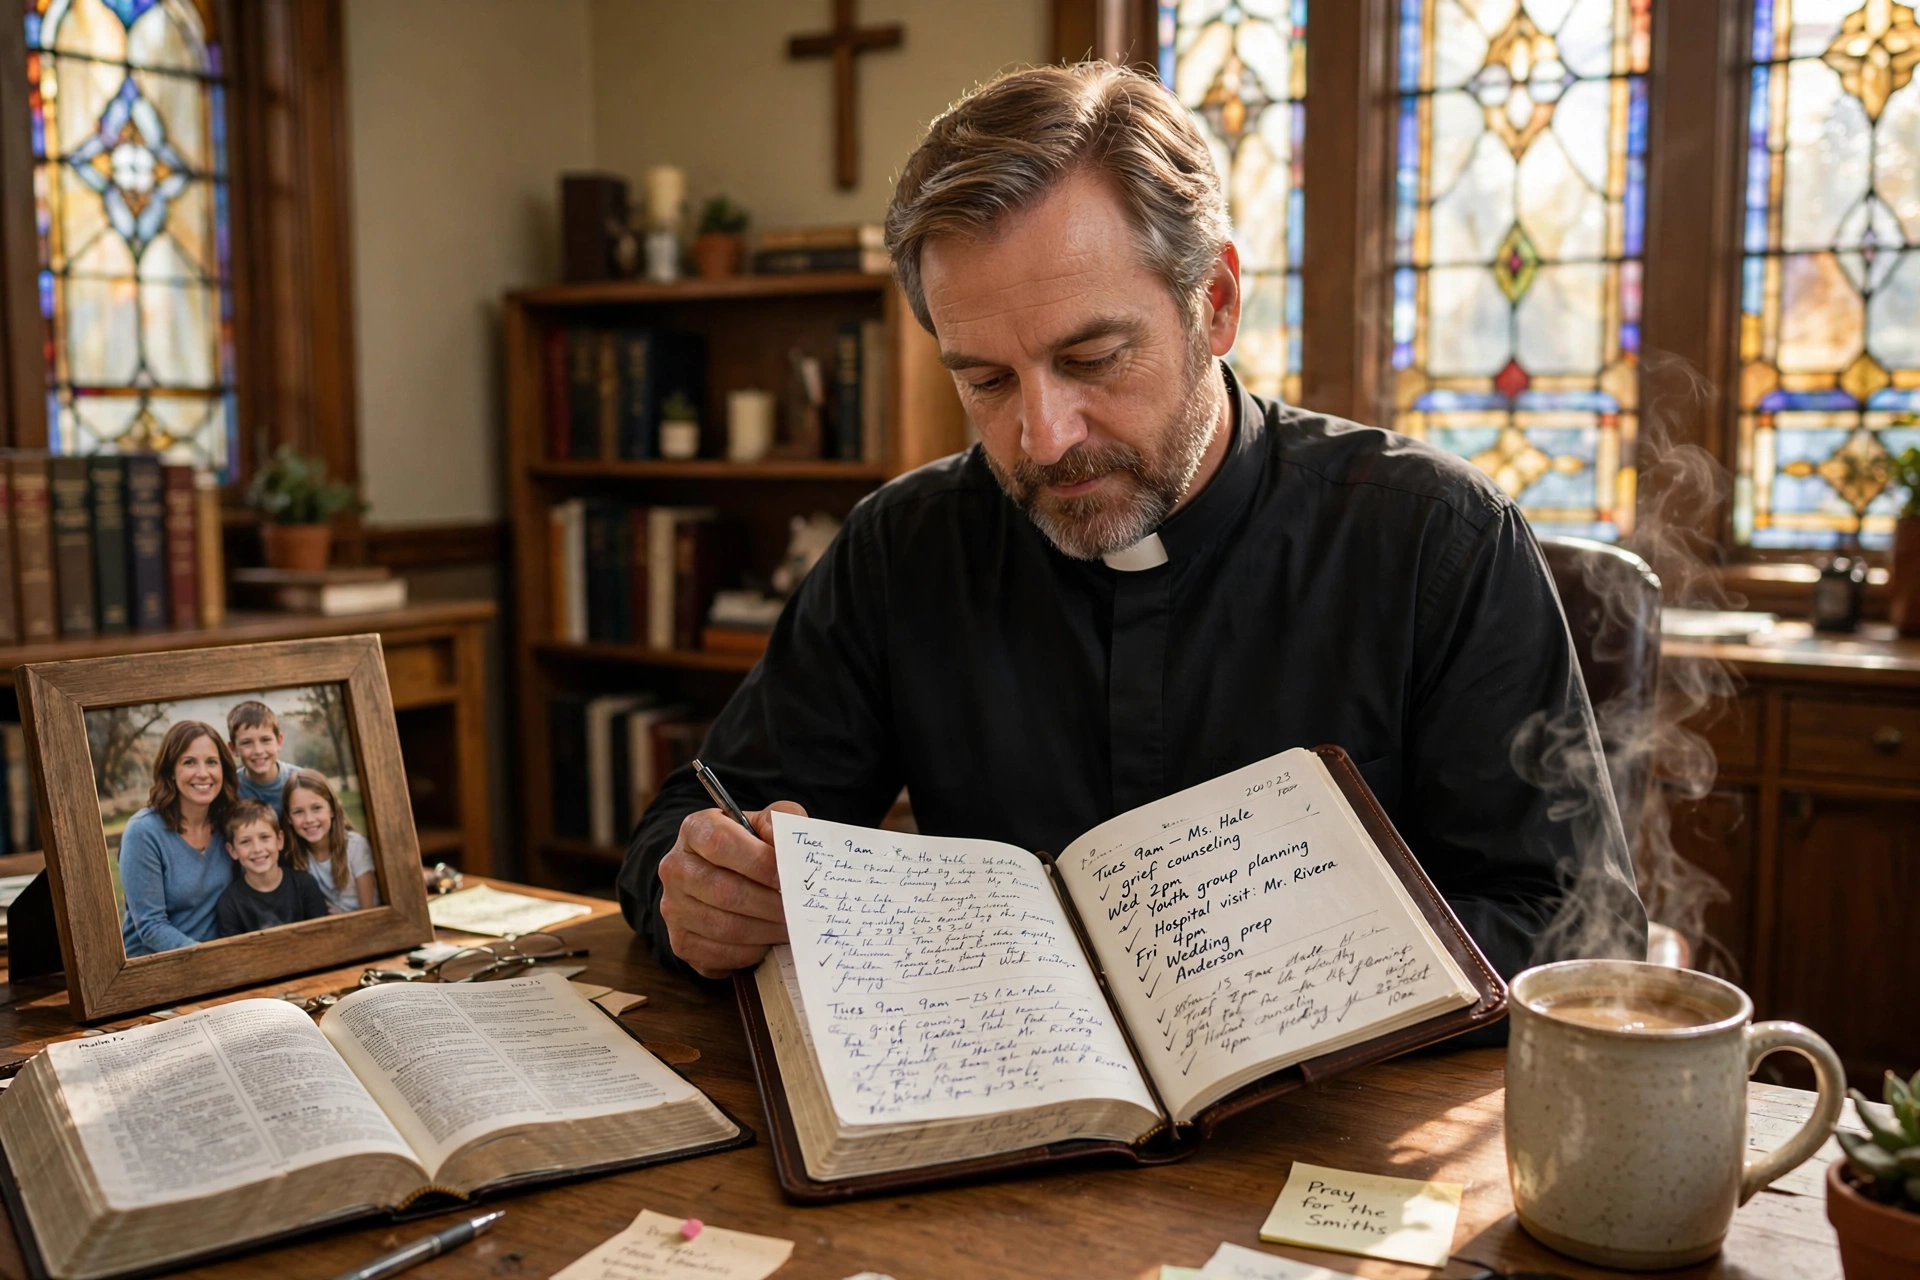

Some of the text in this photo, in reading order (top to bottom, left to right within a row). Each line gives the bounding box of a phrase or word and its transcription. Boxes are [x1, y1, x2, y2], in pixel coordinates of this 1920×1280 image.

[844, 839, 874, 855] 9am
[1092, 860, 1126, 882] Tues
[1134, 844, 1164, 861] 9am
[1187, 825, 1212, 842] Ms.
[1219, 808, 1254, 829] Hale
[1121, 860, 1158, 898] grief
[1167, 833, 1241, 869] counseling
[1147, 840, 1309, 918] Youth group planning
[1108, 877, 1183, 921] Wed 2pm
[1155, 860, 1339, 938] Hospital visit: Mr. Rivera
[1136, 927, 1207, 967] Fri 4pm
[1166, 917, 1272, 968] Wedding prep
[1175, 948, 1244, 984] Anderson
[826, 1001, 865, 1015] Tues
[875, 1001, 904, 1013] 9am
[918, 997, 949, 1010] 9am
[1300, 1196, 1388, 1219] for the
[1307, 1180, 1356, 1203] Pray
[1304, 1213, 1389, 1236] Smiths
